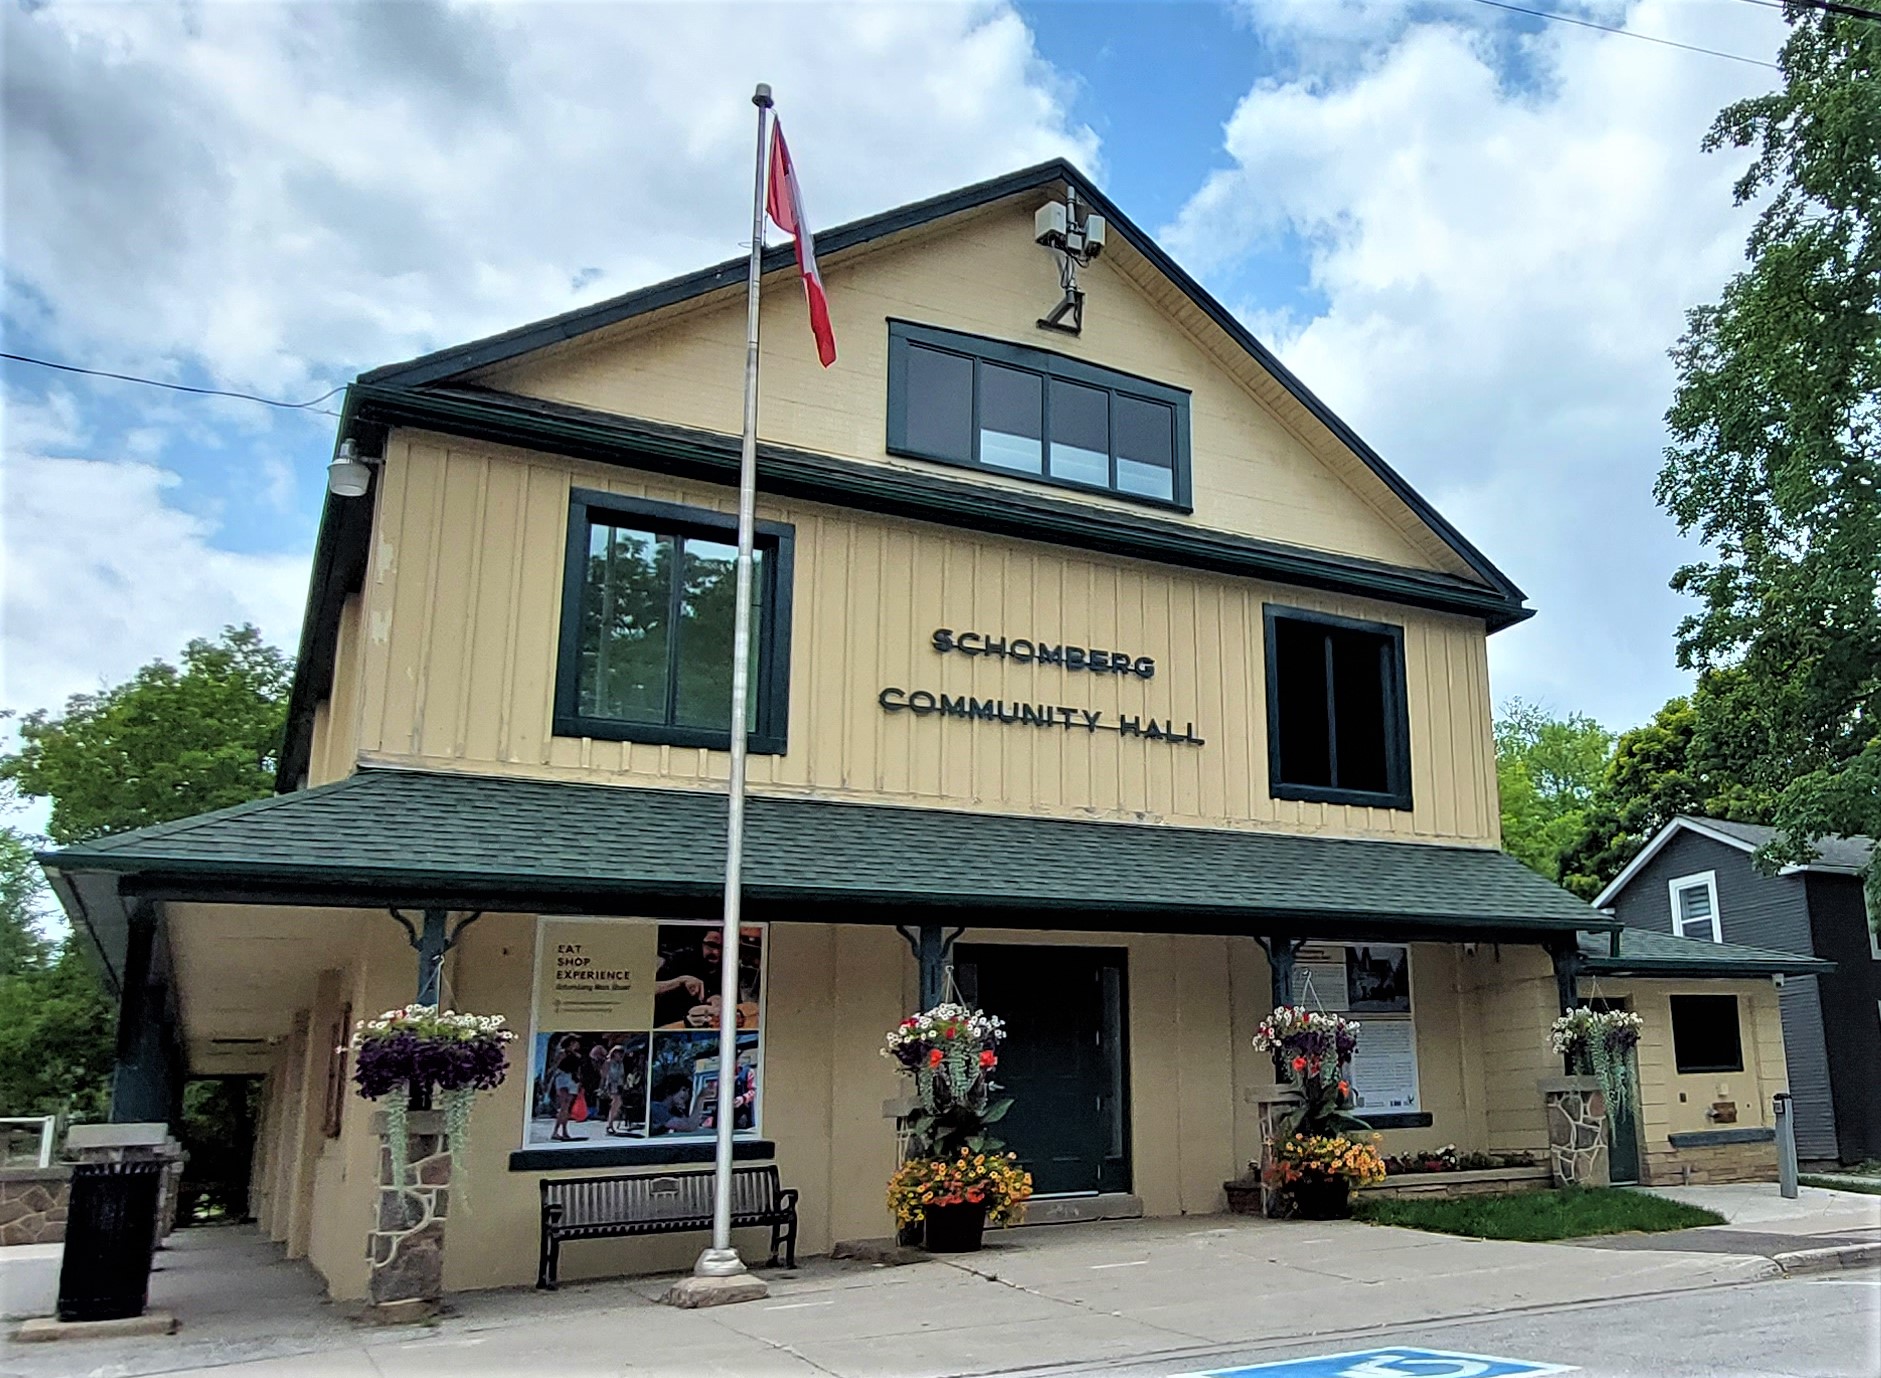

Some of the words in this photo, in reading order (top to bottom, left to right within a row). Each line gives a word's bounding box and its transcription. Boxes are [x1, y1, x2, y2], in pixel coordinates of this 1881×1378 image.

[931, 628, 1155, 679] SCHOMBERG
[878, 687, 1102, 732] COMMUNITY
[1119, 713, 1206, 746] HALL
[558, 945, 582, 954] EAT
[557, 957, 591, 967] SHOP
[556, 970, 630, 980] EXPERIENCE
